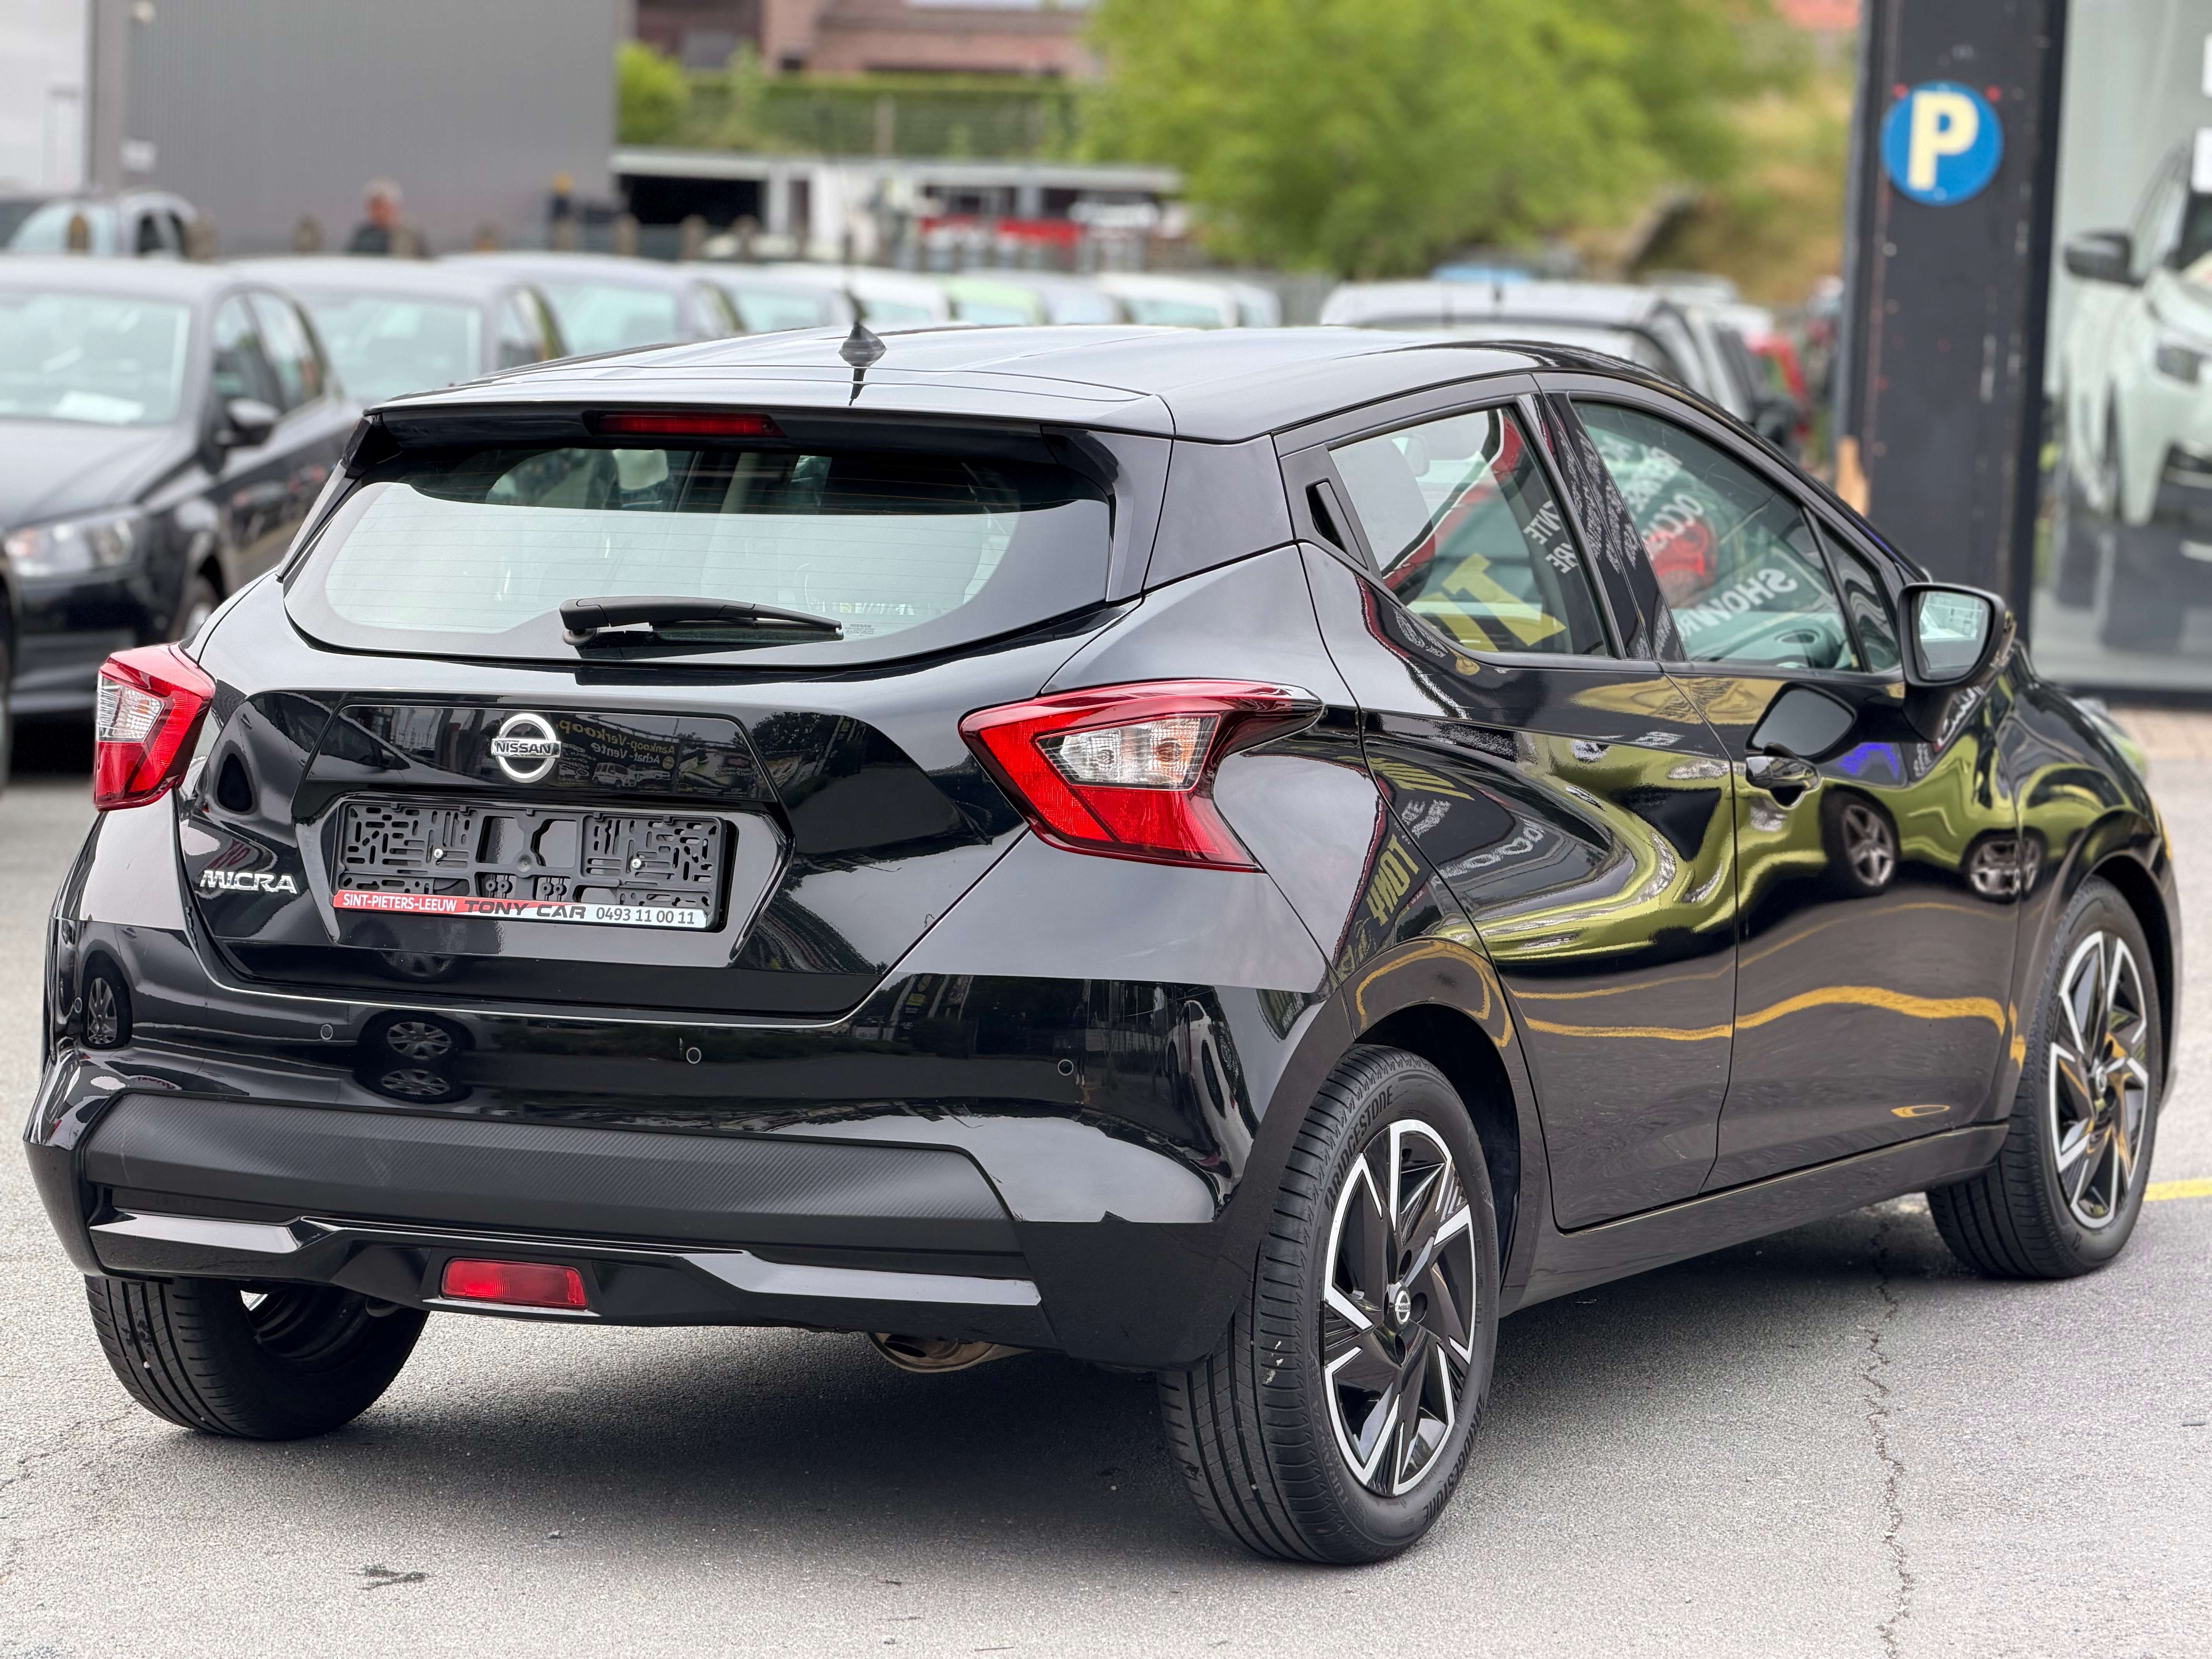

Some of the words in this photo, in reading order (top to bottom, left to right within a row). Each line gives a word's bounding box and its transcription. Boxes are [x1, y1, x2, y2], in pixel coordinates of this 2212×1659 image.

[1907, 90, 1979, 191] P
[496, 742, 551, 754] NISSAN
[200, 870, 297, 894] MICRA
[343, 893, 457, 912] SINT-PIETERS-LEEUW
[464, 900, 529, 915] TONY
[536, 904, 586, 919] CAR
[596, 907, 631, 921] 0493
[635, 909, 651, 922] 11
[656, 910, 674, 923] 00
[678, 912, 695, 924] 11
[1324, 1085, 1393, 1215] BRIDGESTONE
